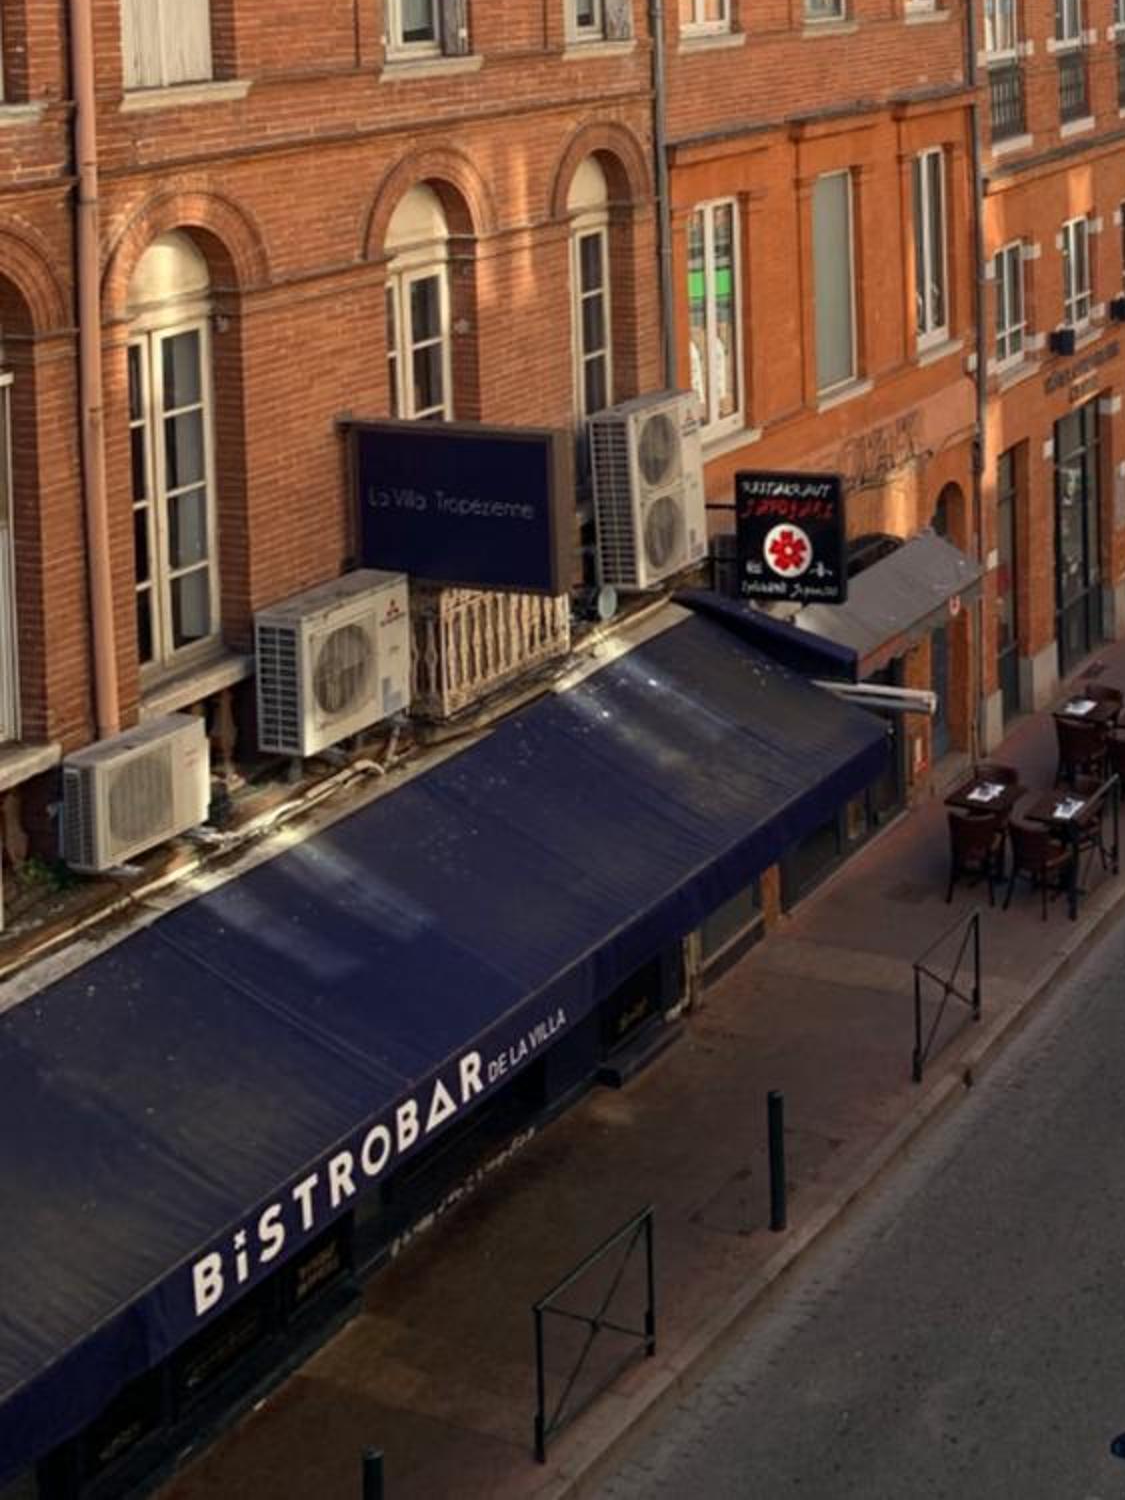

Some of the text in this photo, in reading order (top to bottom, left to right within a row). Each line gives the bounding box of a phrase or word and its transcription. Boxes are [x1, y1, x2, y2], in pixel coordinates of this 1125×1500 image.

[487, 1053, 508, 1083] DE
[509, 1038, 528, 1066] LA
[528, 1007, 567, 1048] VILLA
